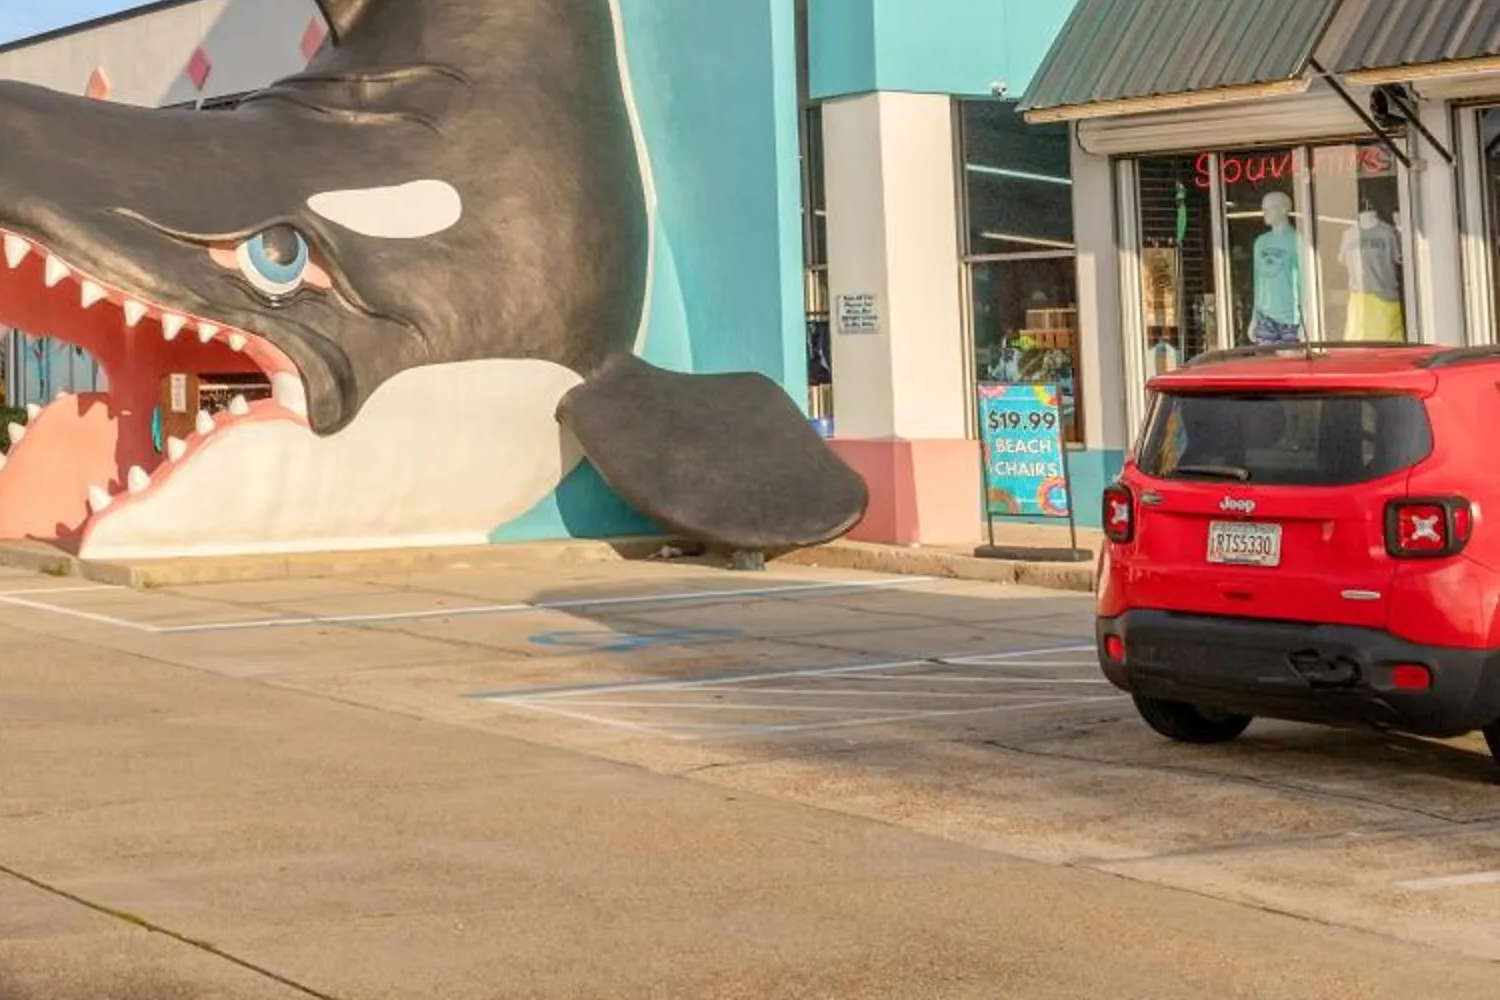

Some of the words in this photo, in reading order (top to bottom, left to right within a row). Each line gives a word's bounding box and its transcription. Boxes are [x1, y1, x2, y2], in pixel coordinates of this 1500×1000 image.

[988, 409, 1057, 433] $19.99
[995, 439, 1053, 453] BEACH
[995, 461, 1058, 477] CHAIRS
